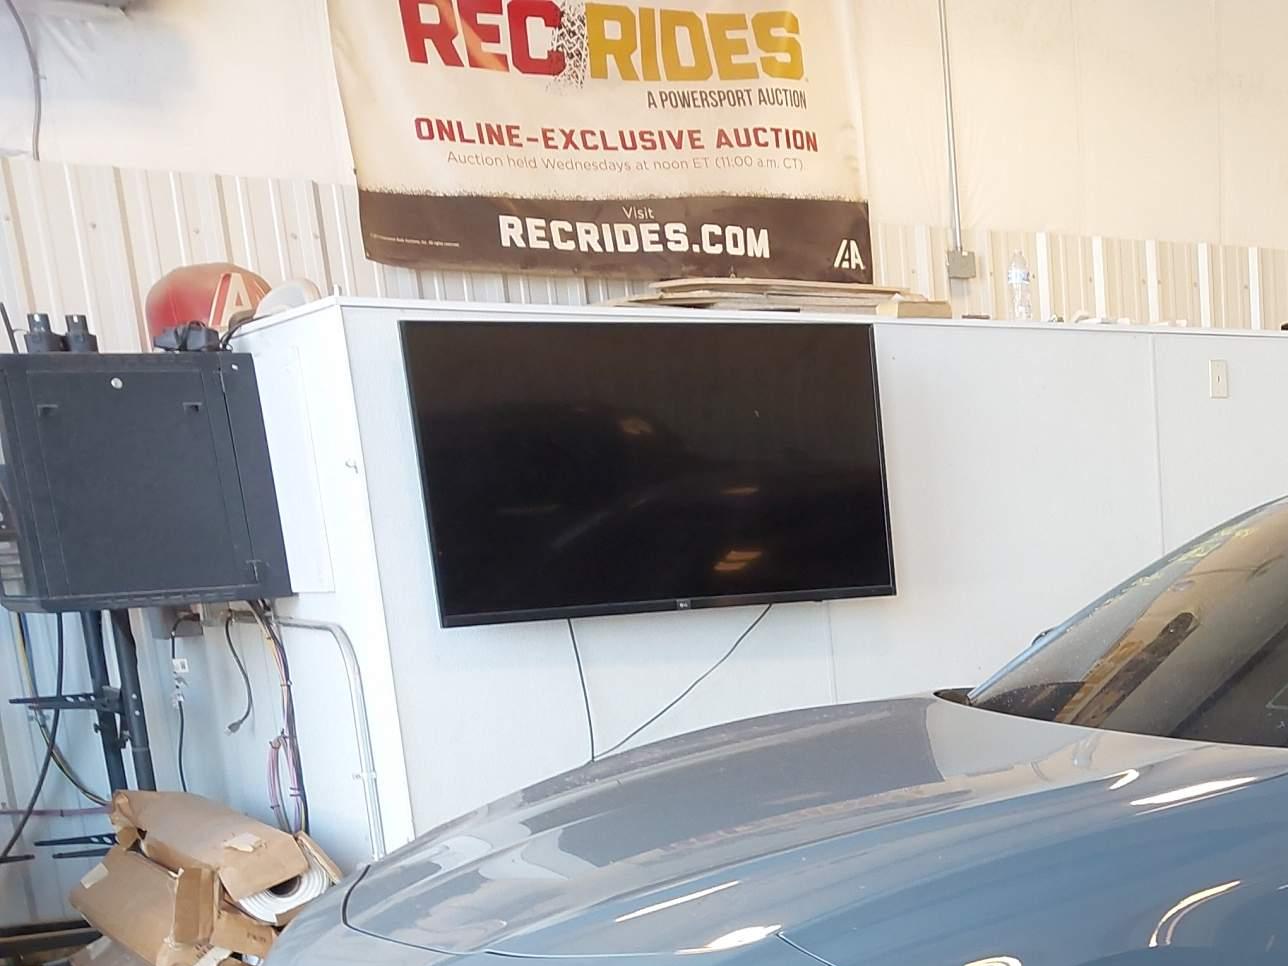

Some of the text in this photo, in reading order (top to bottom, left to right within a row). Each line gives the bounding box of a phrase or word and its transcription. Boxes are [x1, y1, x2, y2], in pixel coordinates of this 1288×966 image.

[399, 0, 805, 82] REC RIDES
[647, 87, 808, 110] A POWERSPORT AUCTION
[414, 117, 818, 153] ONLINE-EXCLUSIVE AUCTION
[447, 151, 504, 168] Auction
[506, 154, 538, 169] held
[541, 157, 632, 172] Wednesdays
[635, 159, 648, 171] at
[653, 161, 689, 171] noon
[693, 157, 710, 169] ET
[715, 155, 753, 170] (11:00
[783, 157, 804, 172] CT)
[622, 206, 654, 220] Visit
[498, 215, 771, 259] RECRIDES.COM
